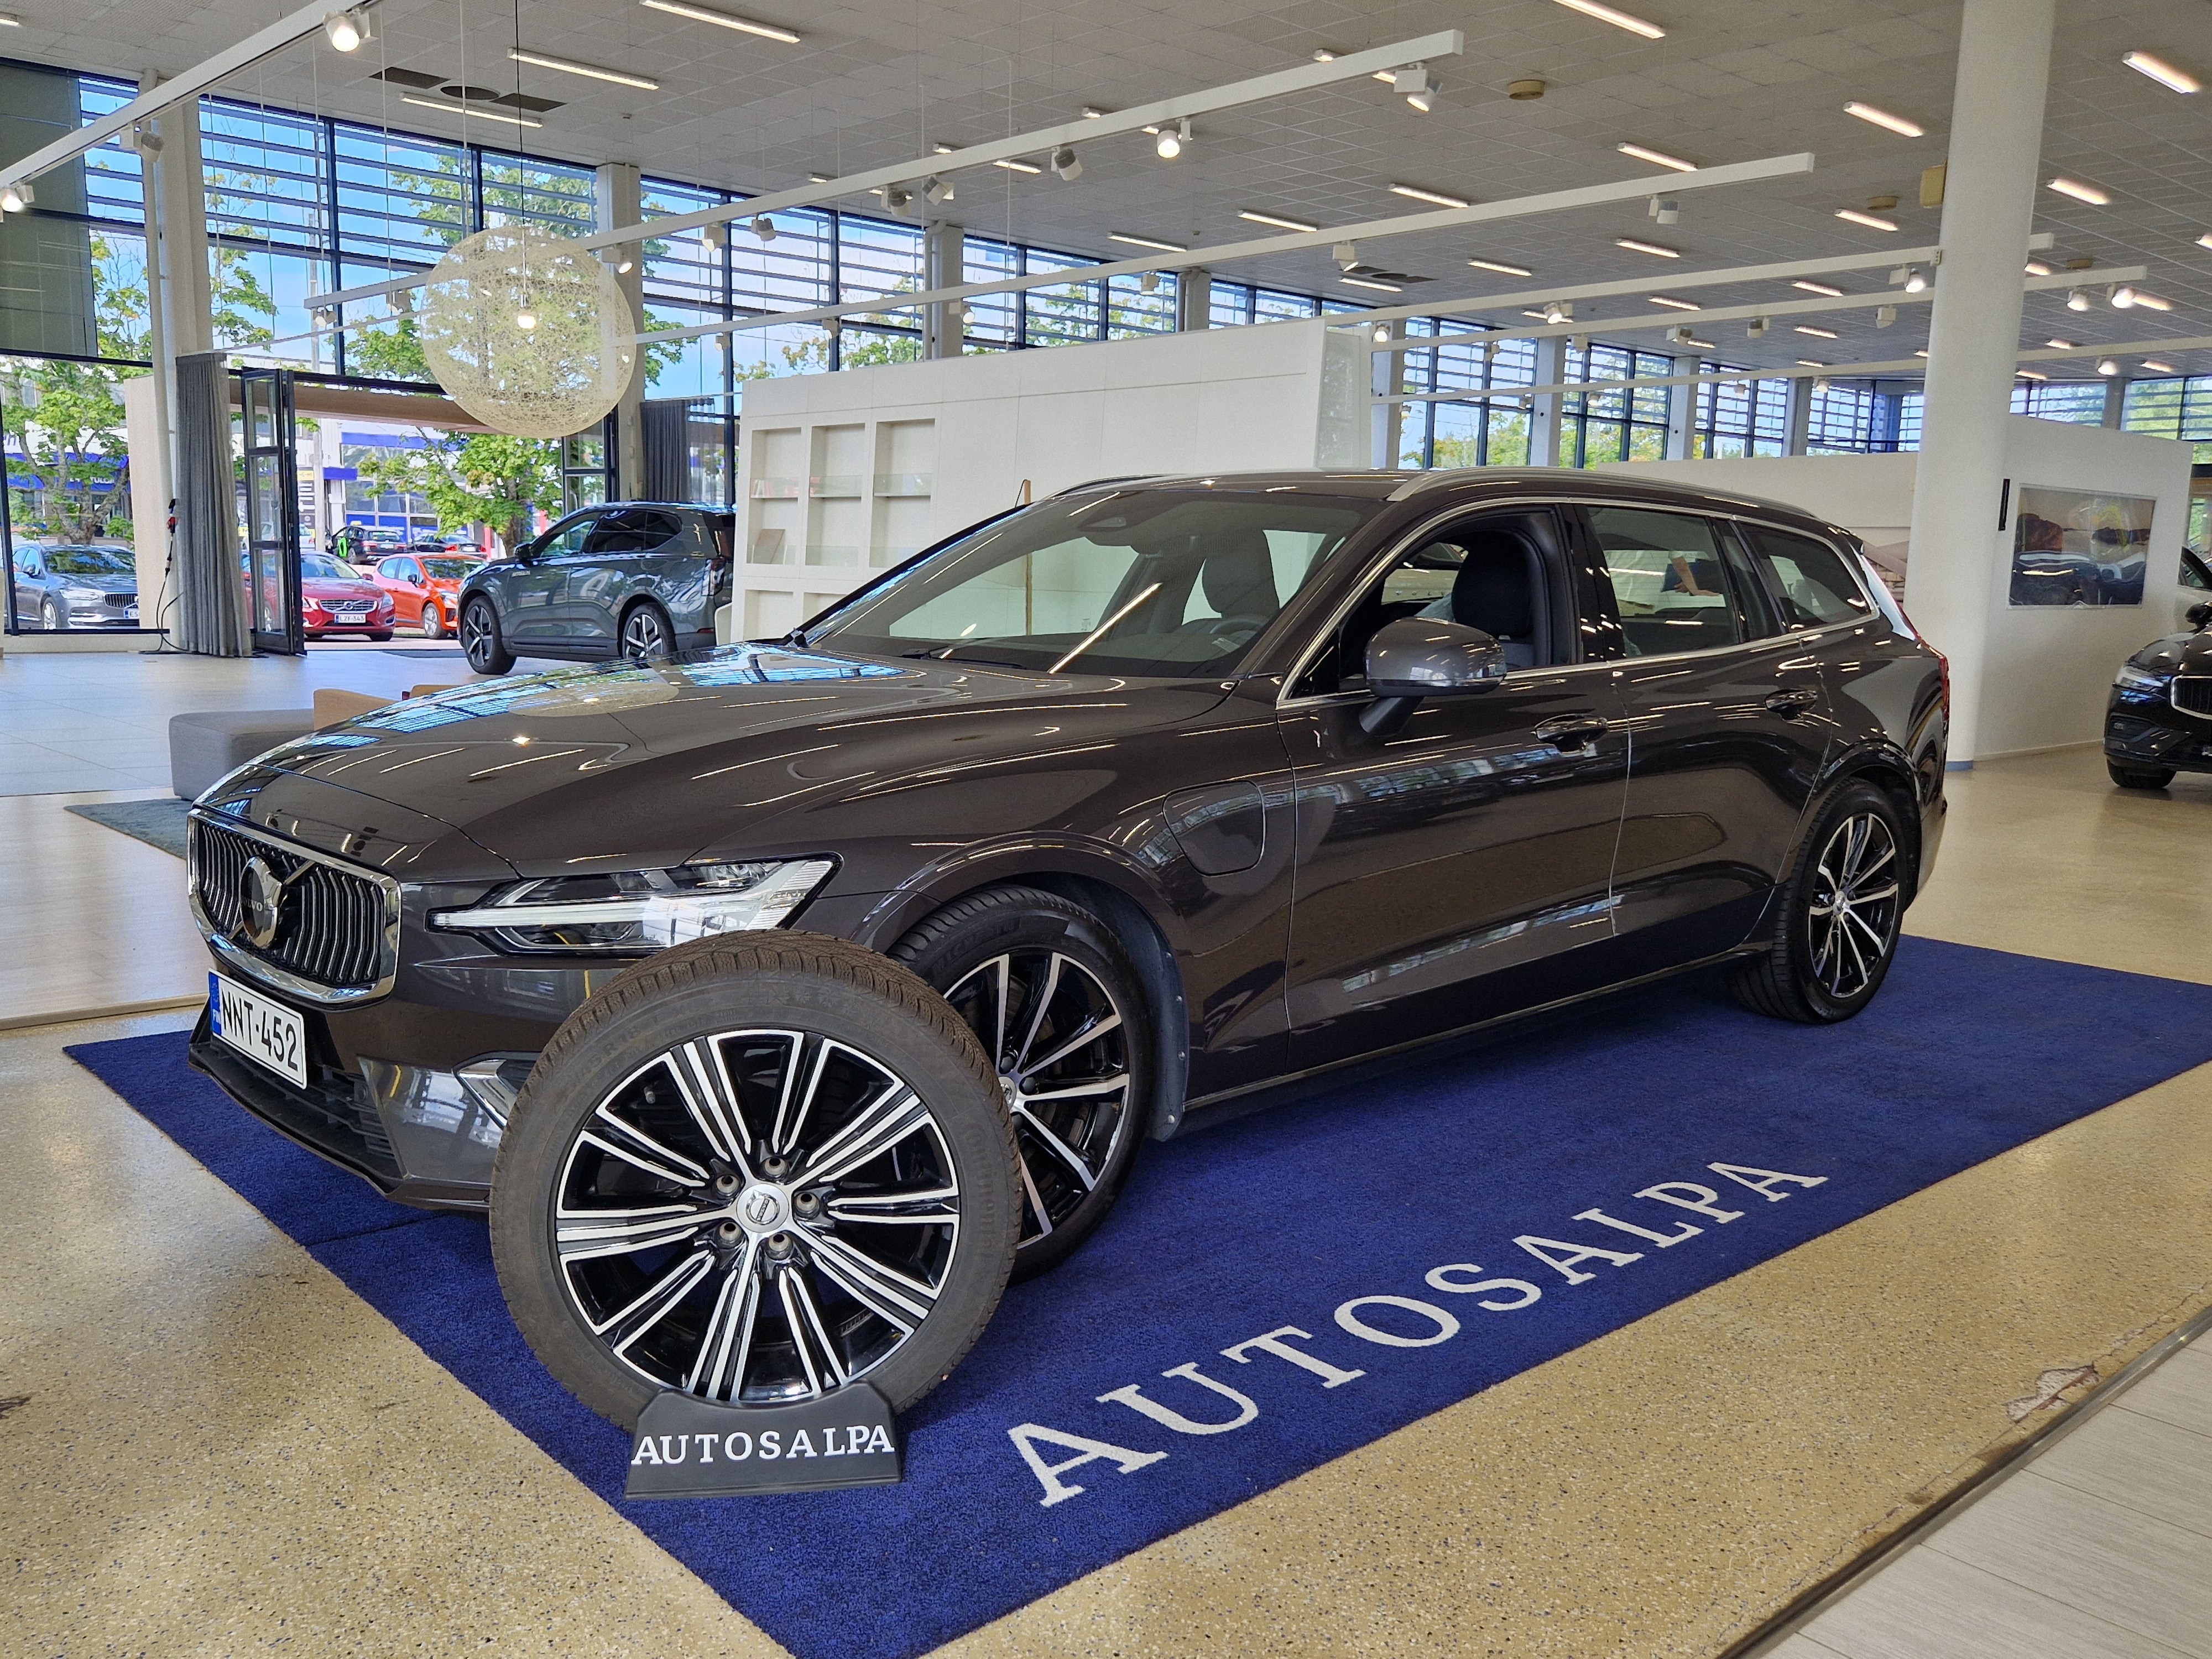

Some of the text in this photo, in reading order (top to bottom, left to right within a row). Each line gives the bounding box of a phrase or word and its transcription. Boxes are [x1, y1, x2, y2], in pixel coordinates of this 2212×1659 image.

[221, 987, 298, 1072] NNT-452
[1008, 1161, 1828, 1507] AUTOSALPA
[630, 1425, 895, 1465] AUTOSALPA
